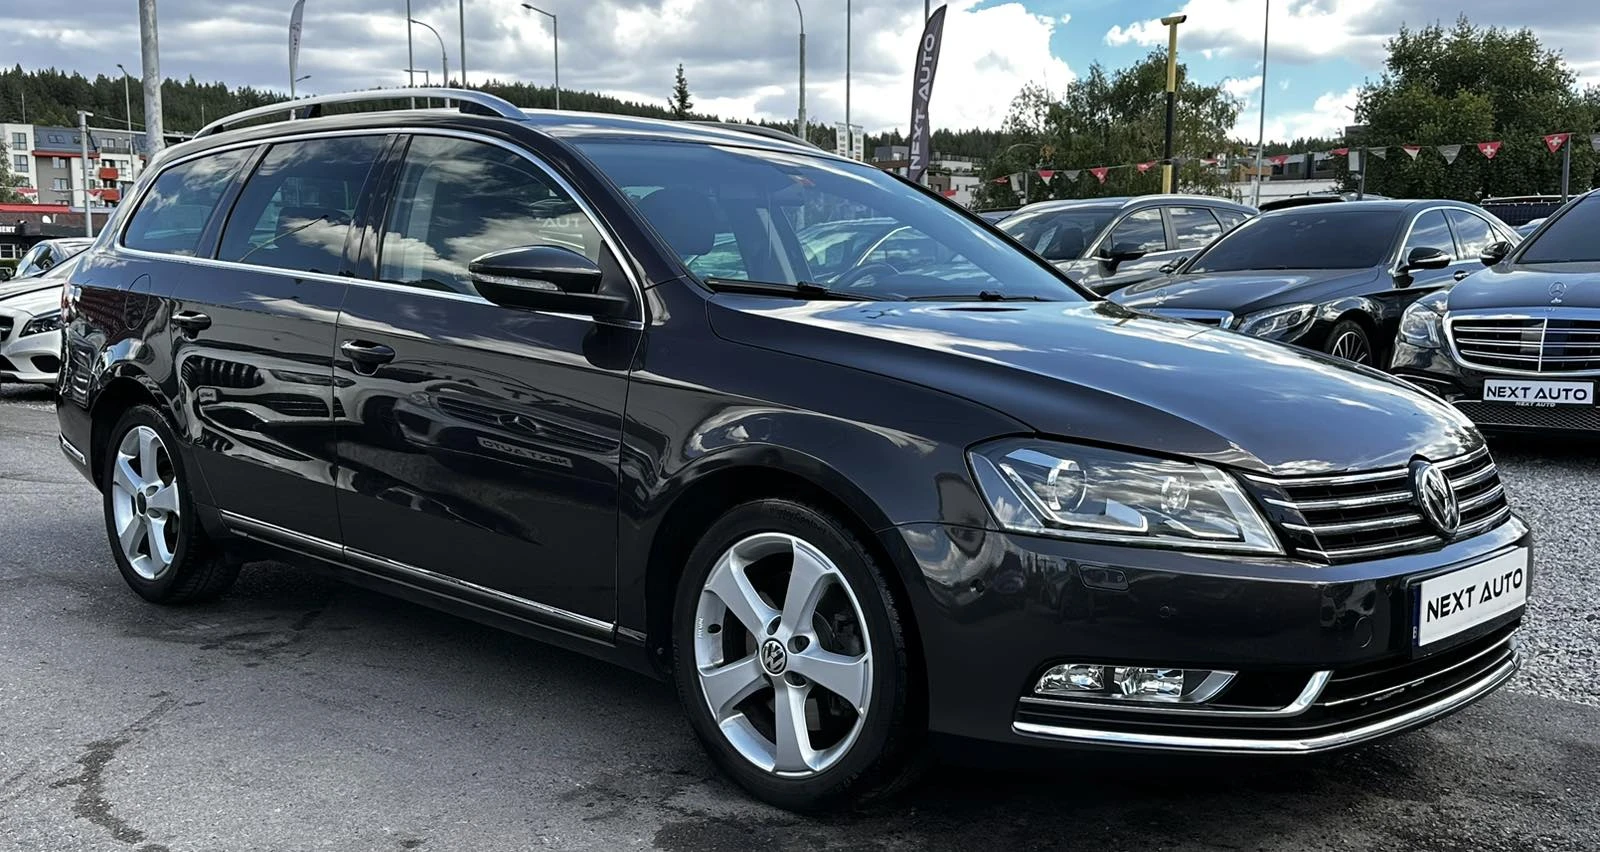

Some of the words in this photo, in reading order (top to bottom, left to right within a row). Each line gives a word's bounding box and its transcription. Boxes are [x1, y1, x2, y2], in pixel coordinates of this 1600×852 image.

[909, 109, 926, 170] NEXT
[918, 33, 935, 102] AUTO
[1486, 386, 1531, 398] NEXT
[1534, 387, 1588, 401] AUTO
[1426, 585, 1477, 622] NEXT
[1479, 568, 1523, 604] AUTO
